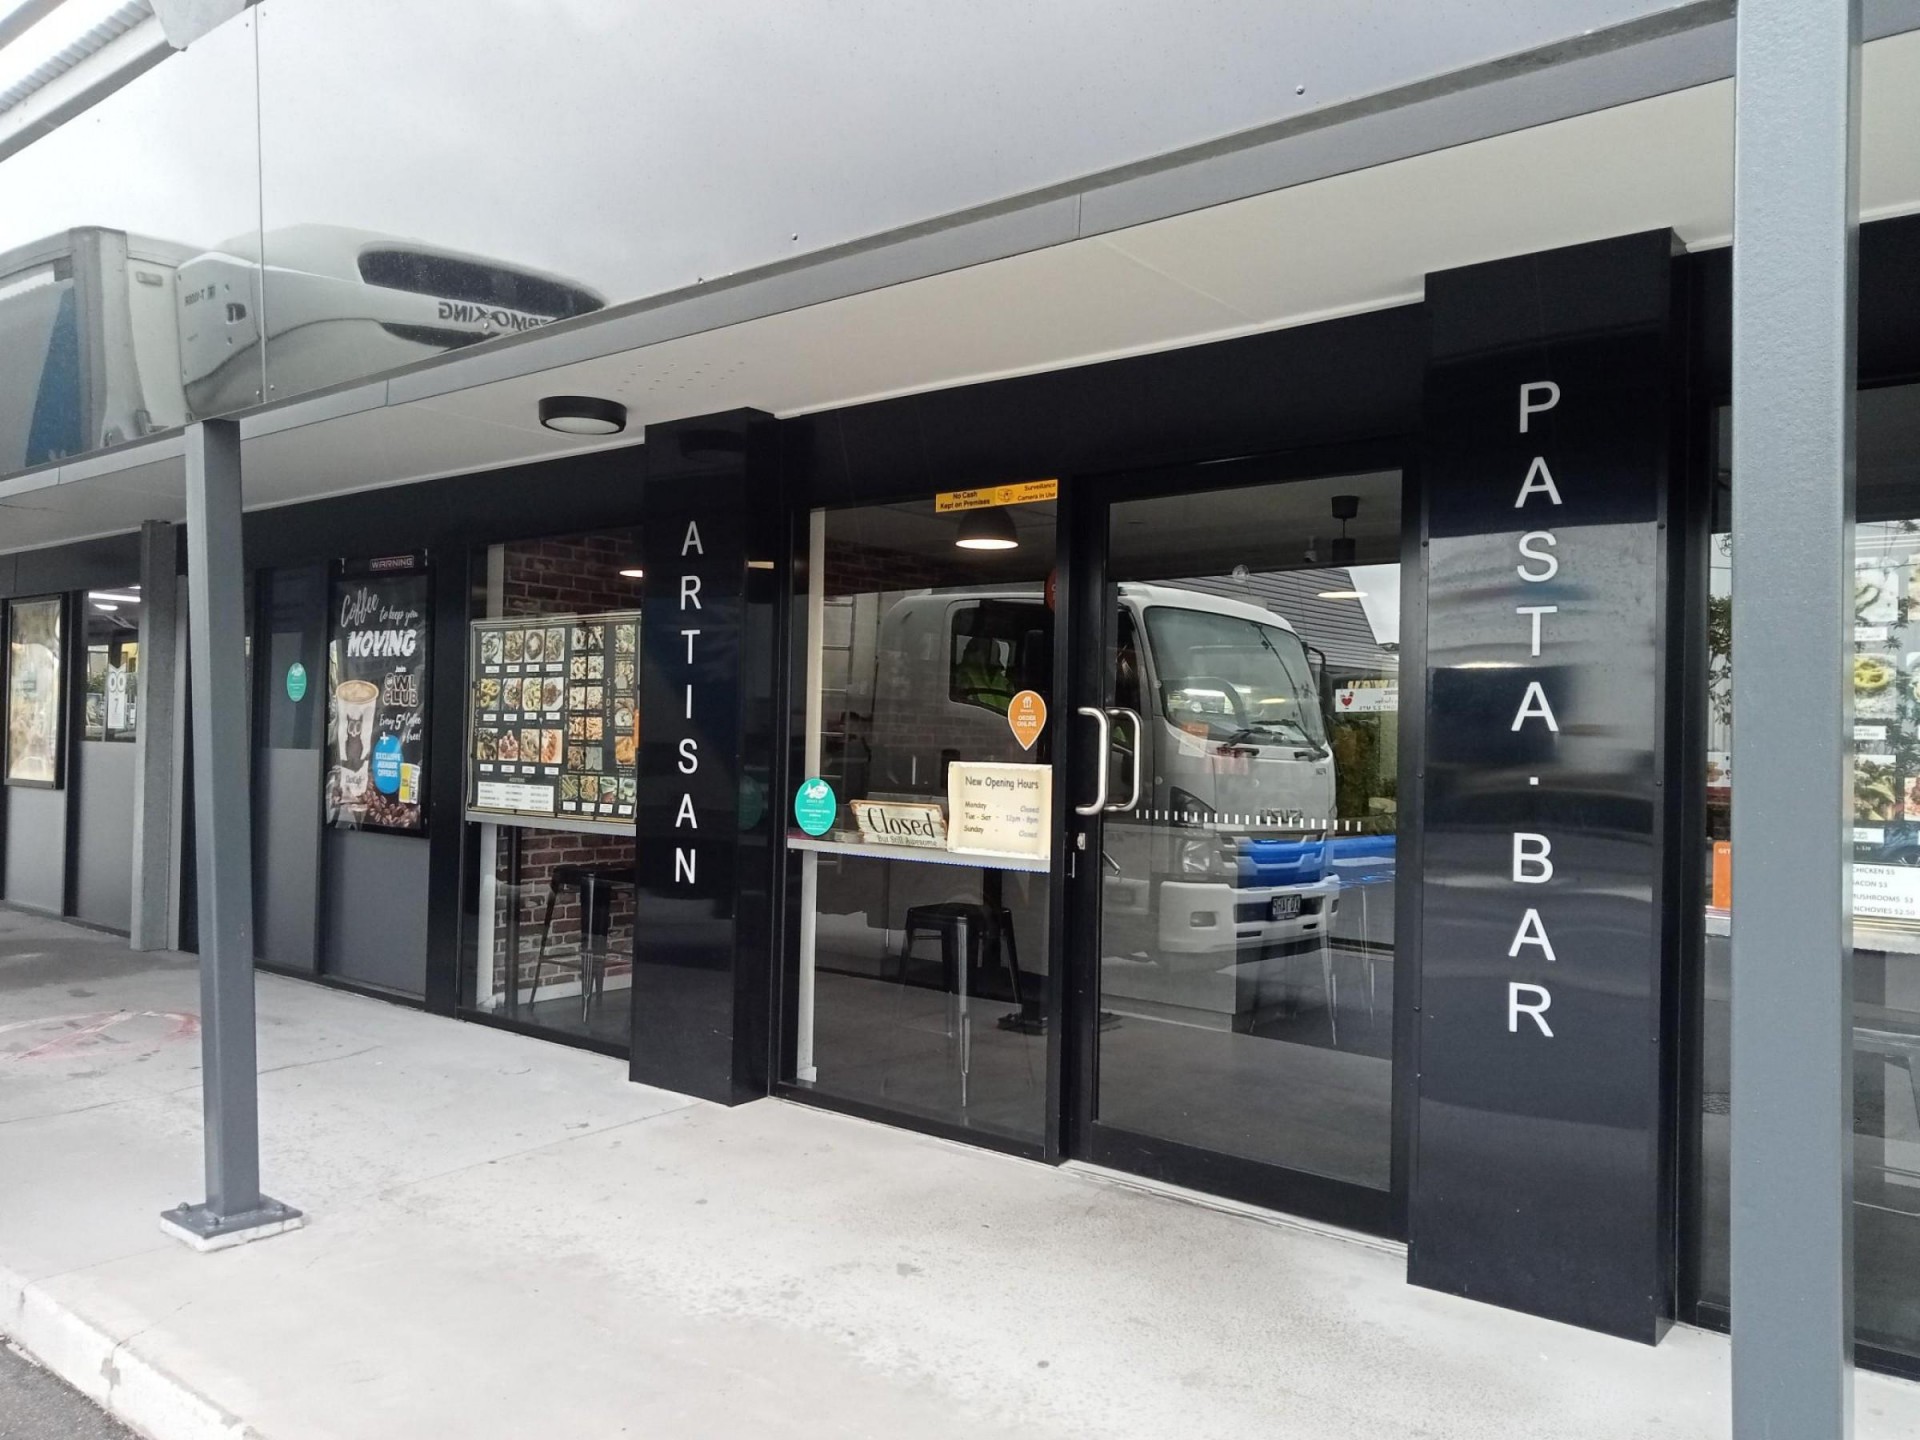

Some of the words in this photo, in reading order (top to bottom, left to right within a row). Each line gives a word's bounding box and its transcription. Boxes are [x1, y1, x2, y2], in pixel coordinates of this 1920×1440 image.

[1024, 482, 1057, 491] Surveillance
[962, 490, 978, 499] Cash
[1017, 493, 1039, 502] Camera
[940, 502, 954, 510] Kept
[963, 498, 991, 507] Premises
[371, 557, 414, 569] WARNING
[341, 586, 379, 628] Coffee
[379, 606, 388, 623] to
[388, 605, 404, 626] keep
[347, 629, 417, 657] MOVING
[384, 672, 417, 690] OWL
[382, 689, 419, 708] CLUB
[675, 520, 704, 884] ARTISAN
[380, 713, 395, 730] Every
[405, 711, 421, 728] Coffee
[965, 776, 982, 786] New
[985, 776, 1015, 791] Opening
[1017, 778, 1040, 789] Hours
[965, 801, 987, 811] Monday
[1020, 805, 1040, 814] Closed
[867, 807, 935, 838] Closed
[965, 812, 976, 820] Tue
[980, 813, 992, 821] Sat
[963, 825, 984, 835] Sunday
[1018, 830, 1039, 839] Closed
[877, 834, 889, 843] But
[890, 835, 903, 844] Still
[905, 836, 938, 848] Awesome
[1854, 905, 1893, 914] NCHOVIES
